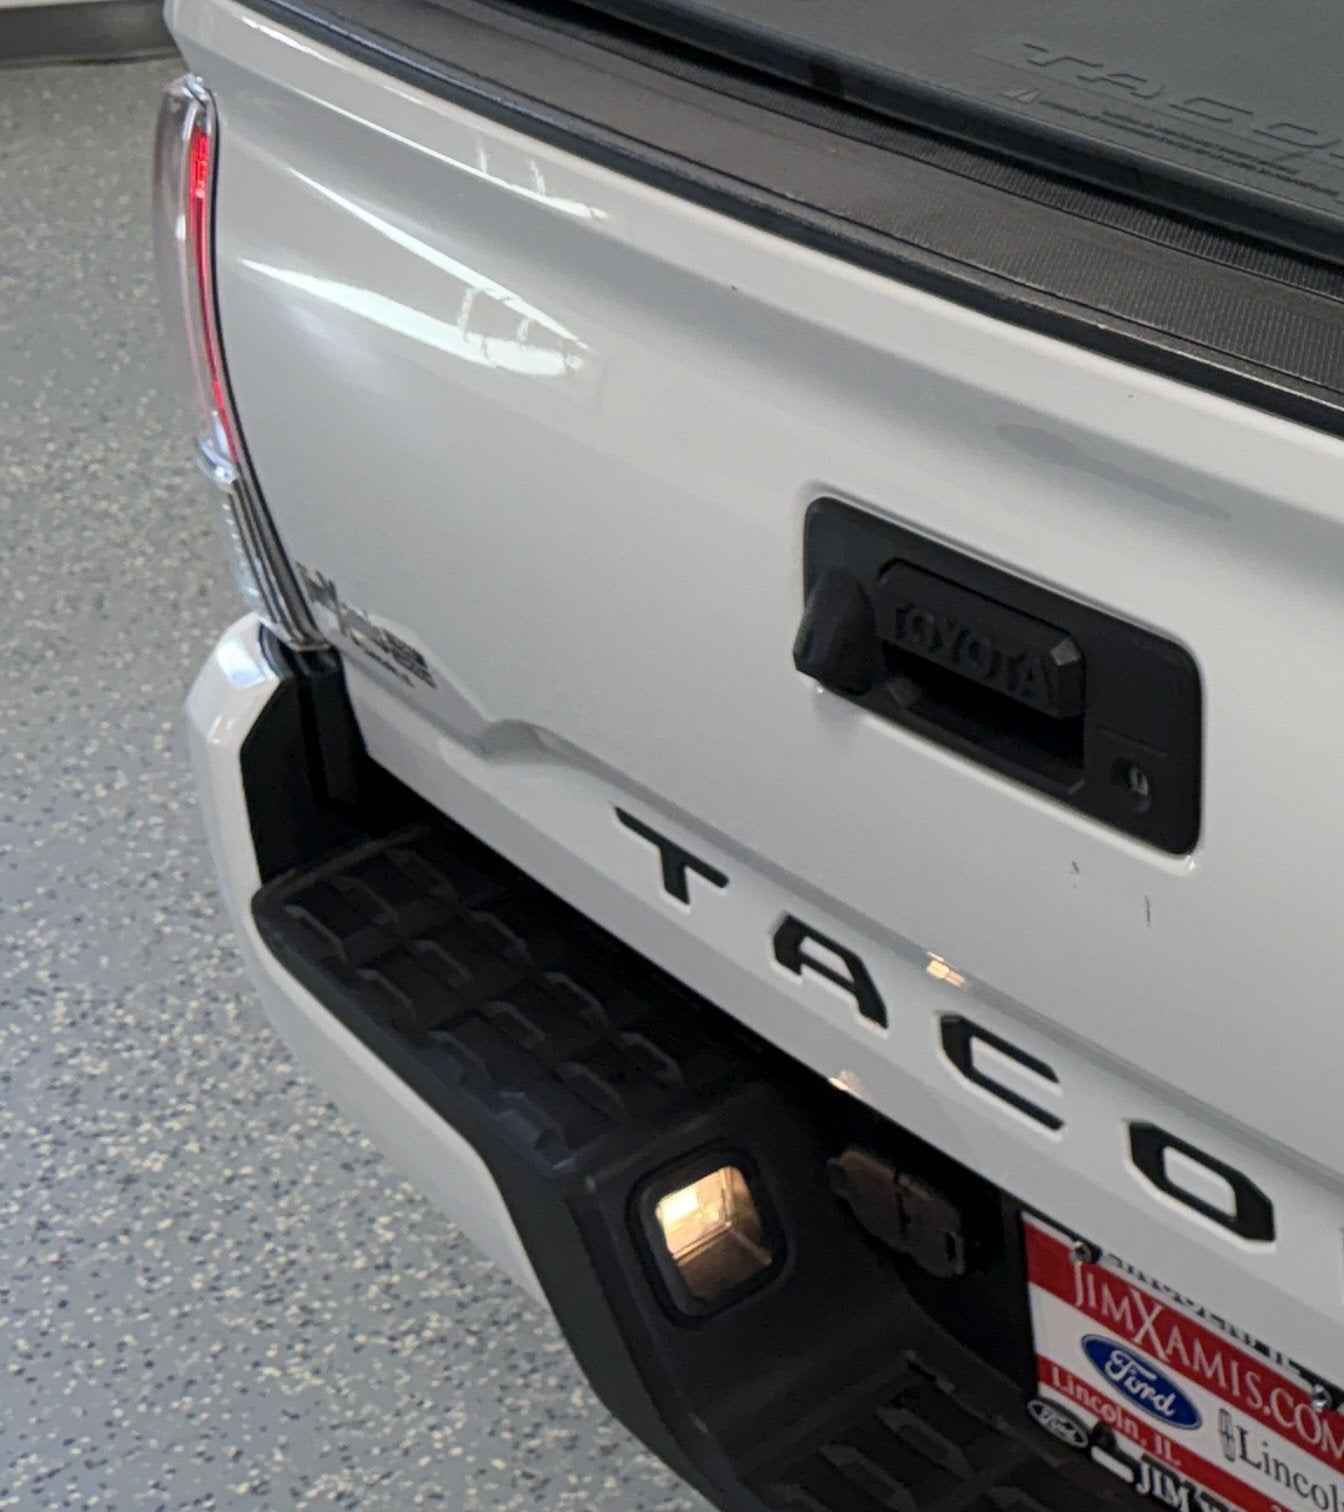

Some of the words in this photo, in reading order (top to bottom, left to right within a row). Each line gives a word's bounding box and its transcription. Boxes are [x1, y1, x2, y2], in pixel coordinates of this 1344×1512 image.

[886, 598, 1056, 705] TOYOTA
[1051, 1365, 1149, 1449] Lincoln,
[1153, 1433, 1183, 1468] IL
[1103, 1349, 1178, 1417] Ford
